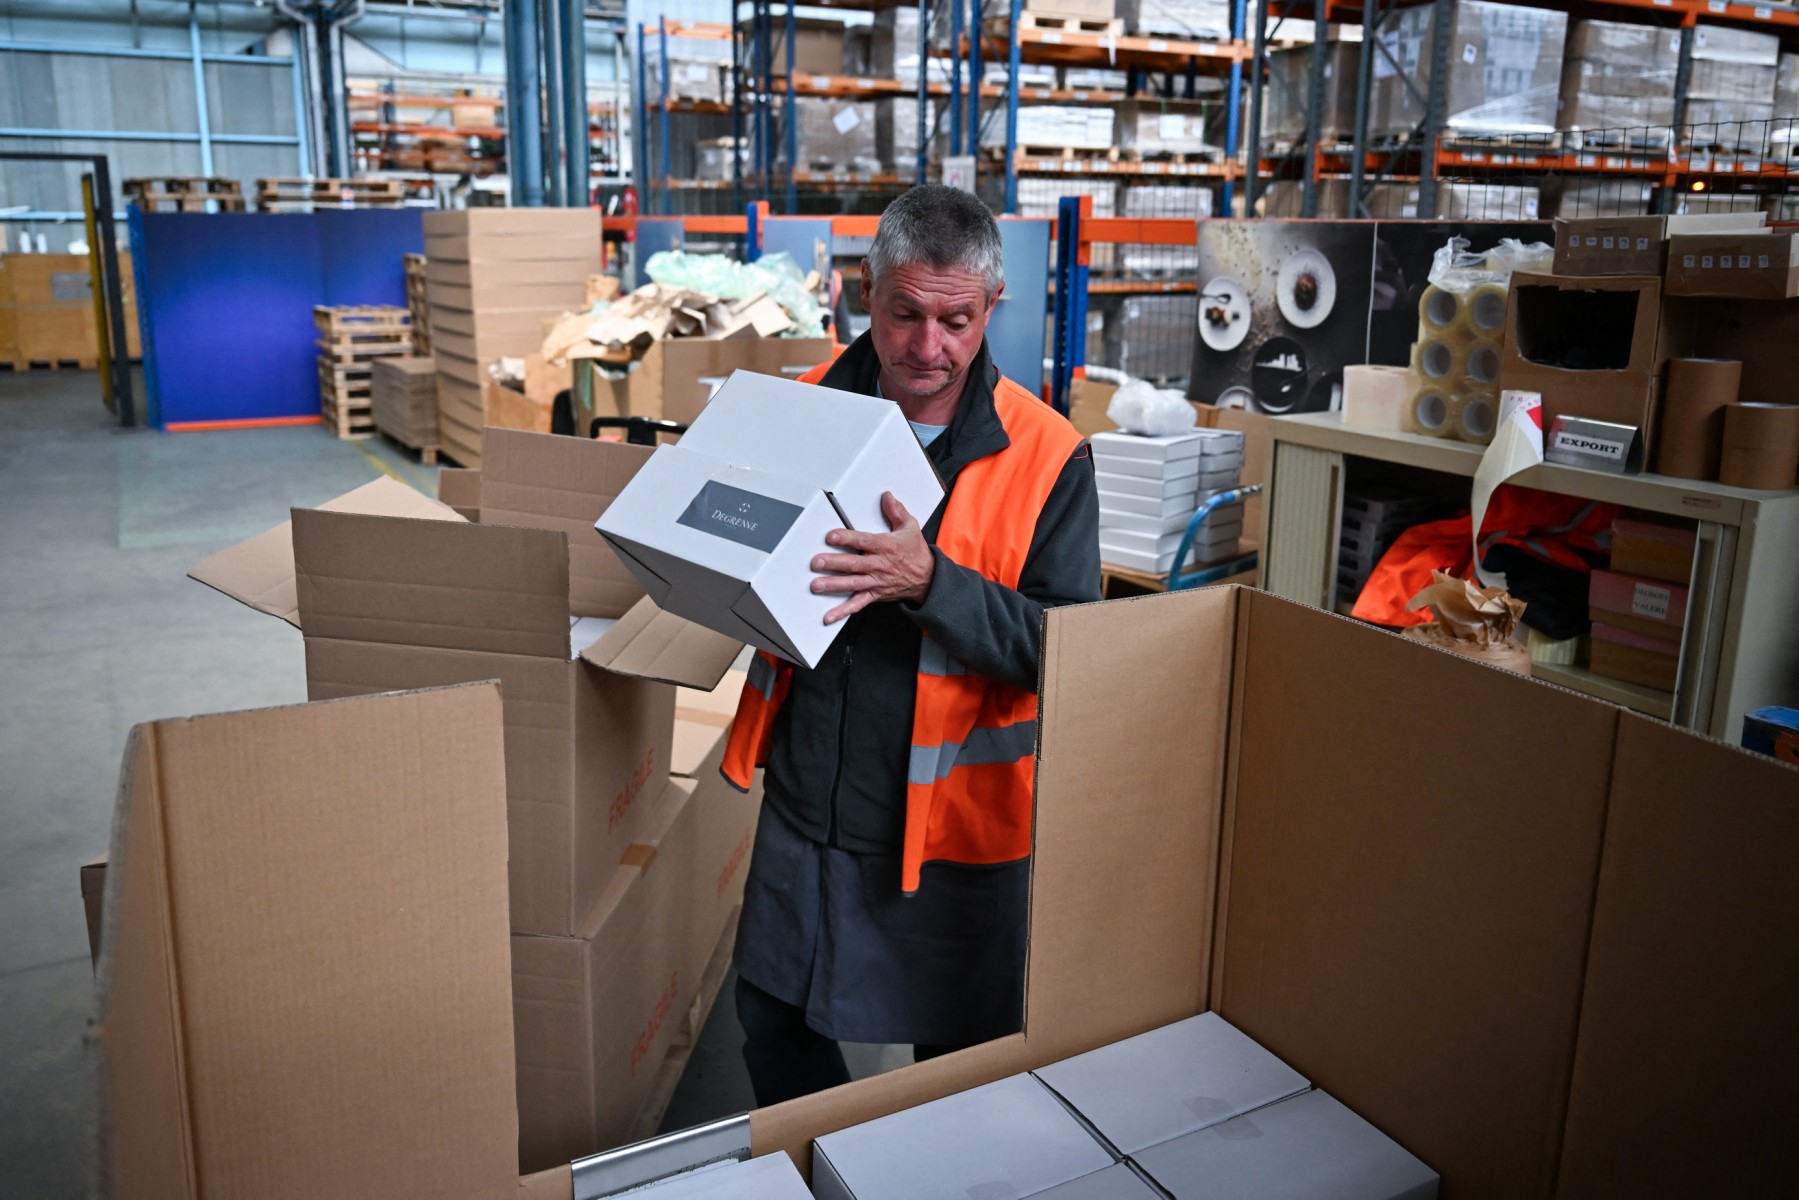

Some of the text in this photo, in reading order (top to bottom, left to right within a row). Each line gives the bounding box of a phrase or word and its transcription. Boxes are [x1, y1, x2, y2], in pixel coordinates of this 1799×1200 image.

[1561, 436, 1619, 454] EXPORT
[608, 747, 654, 837] FRAGILE
[630, 970, 678, 1079] FRAGILE
